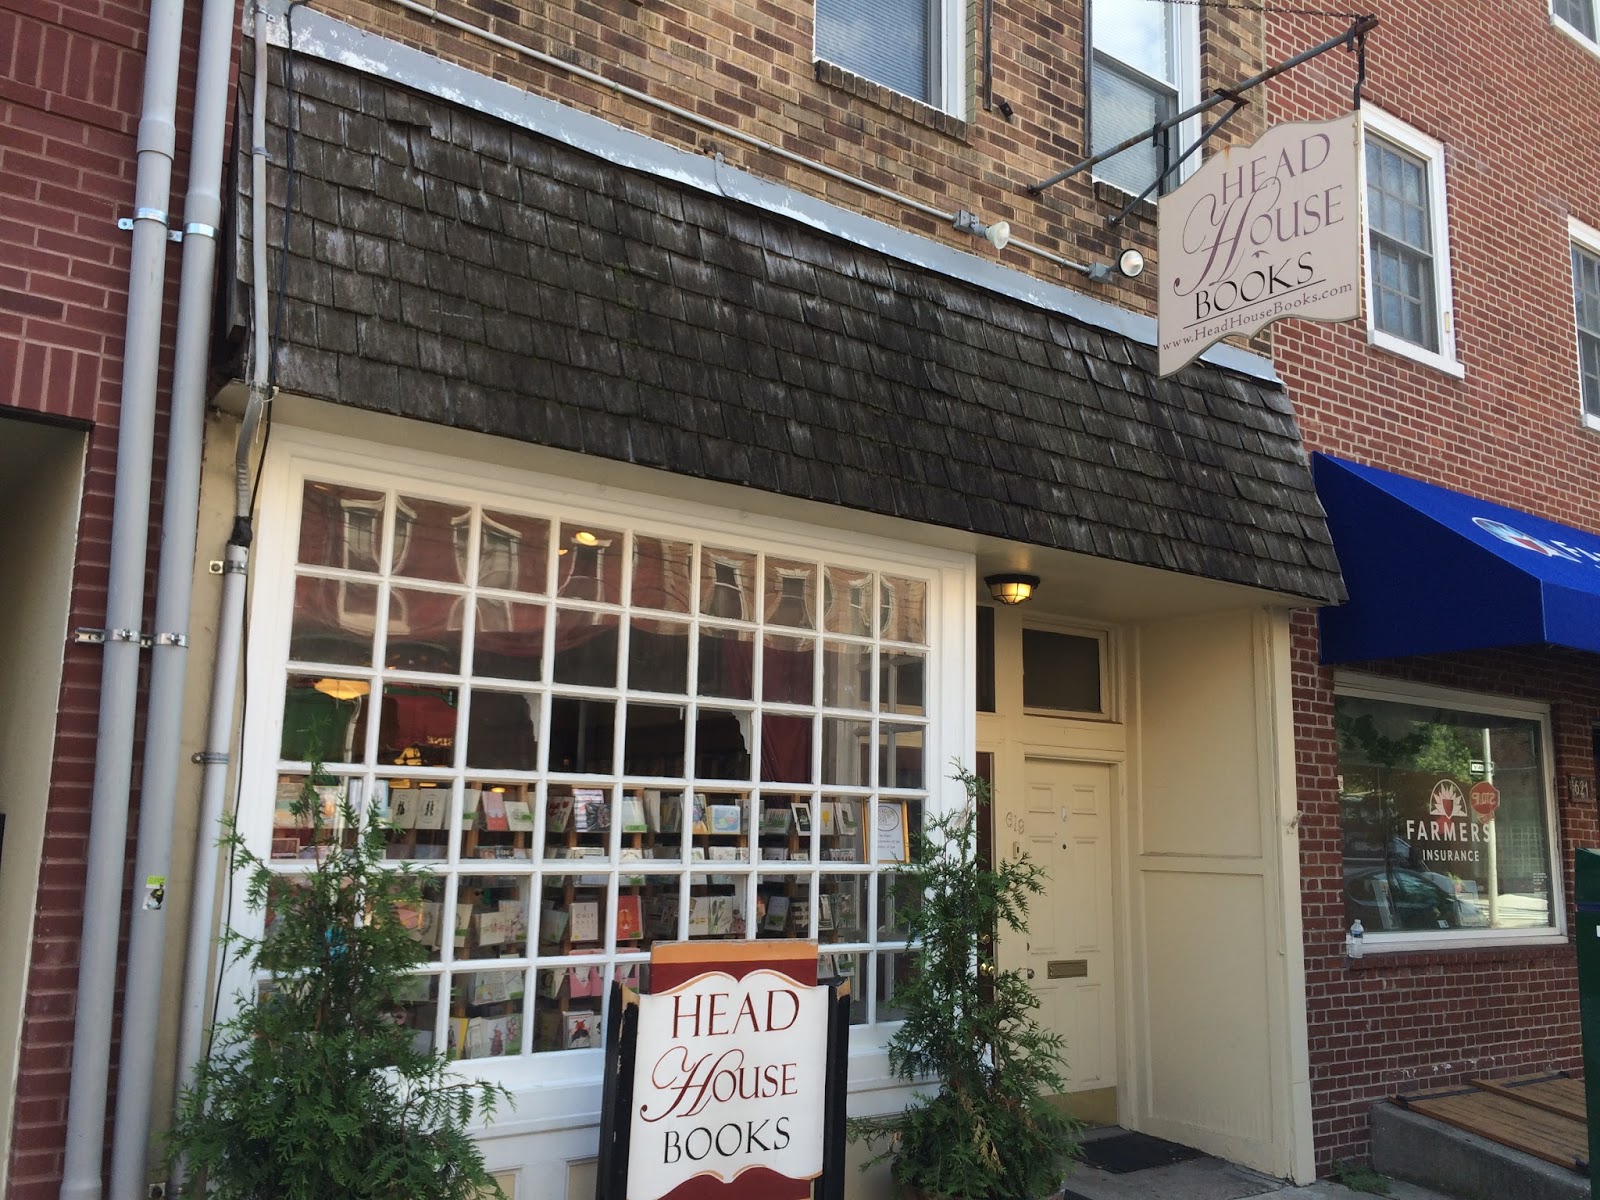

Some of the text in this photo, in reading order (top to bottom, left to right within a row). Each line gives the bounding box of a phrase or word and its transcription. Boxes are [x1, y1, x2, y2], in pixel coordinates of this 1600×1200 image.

[1221, 133, 1331, 206] HEAD
[1173, 176, 1345, 297] HOUSE
[1162, 282, 1353, 351] www.HeadHouseBooks.com
[1195, 251, 1314, 320] BOOKS
[1406, 819, 1491, 843] FARMERS
[1422, 849, 1480, 862] INSURANCE
[671, 989, 800, 1039] HEAD
[639, 1045, 798, 1123] HOUSE
[663, 1116, 791, 1164] BOOKS
